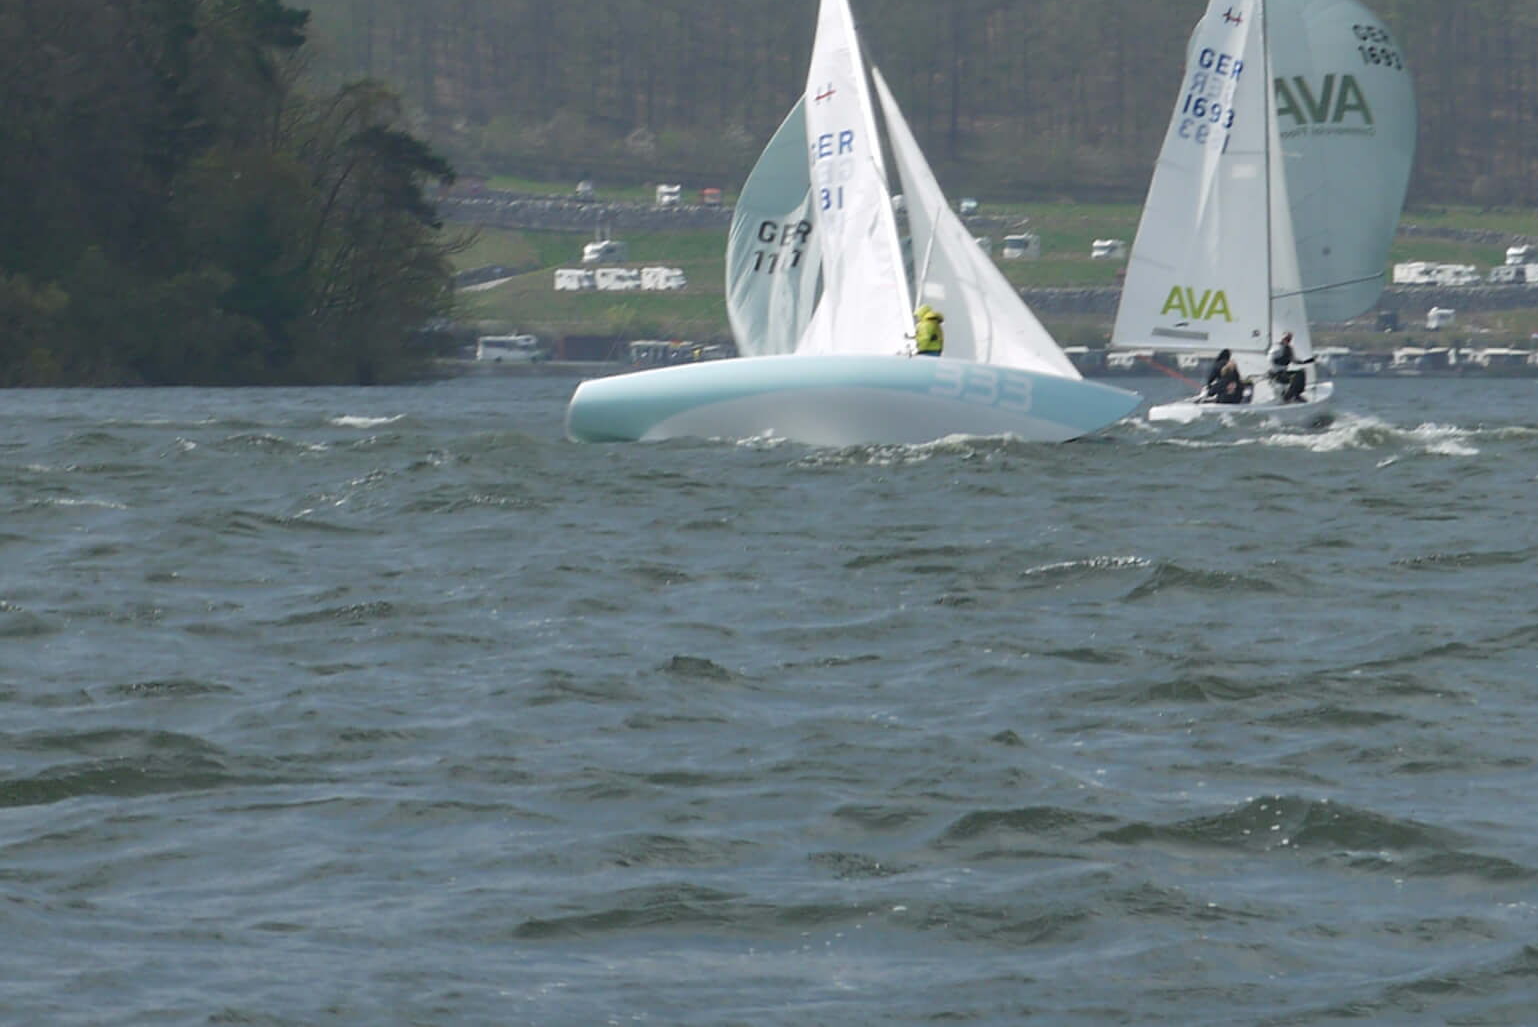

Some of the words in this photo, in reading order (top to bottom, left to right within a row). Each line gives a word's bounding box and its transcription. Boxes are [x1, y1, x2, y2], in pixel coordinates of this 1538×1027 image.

[1200, 47, 1244, 78] GER
[1182, 93, 1236, 129] 1693
[1274, 72, 1375, 125] AVA
[811, 129, 854, 163] ER
[758, 219, 813, 246] GER
[1160, 284, 1233, 323] AVA
